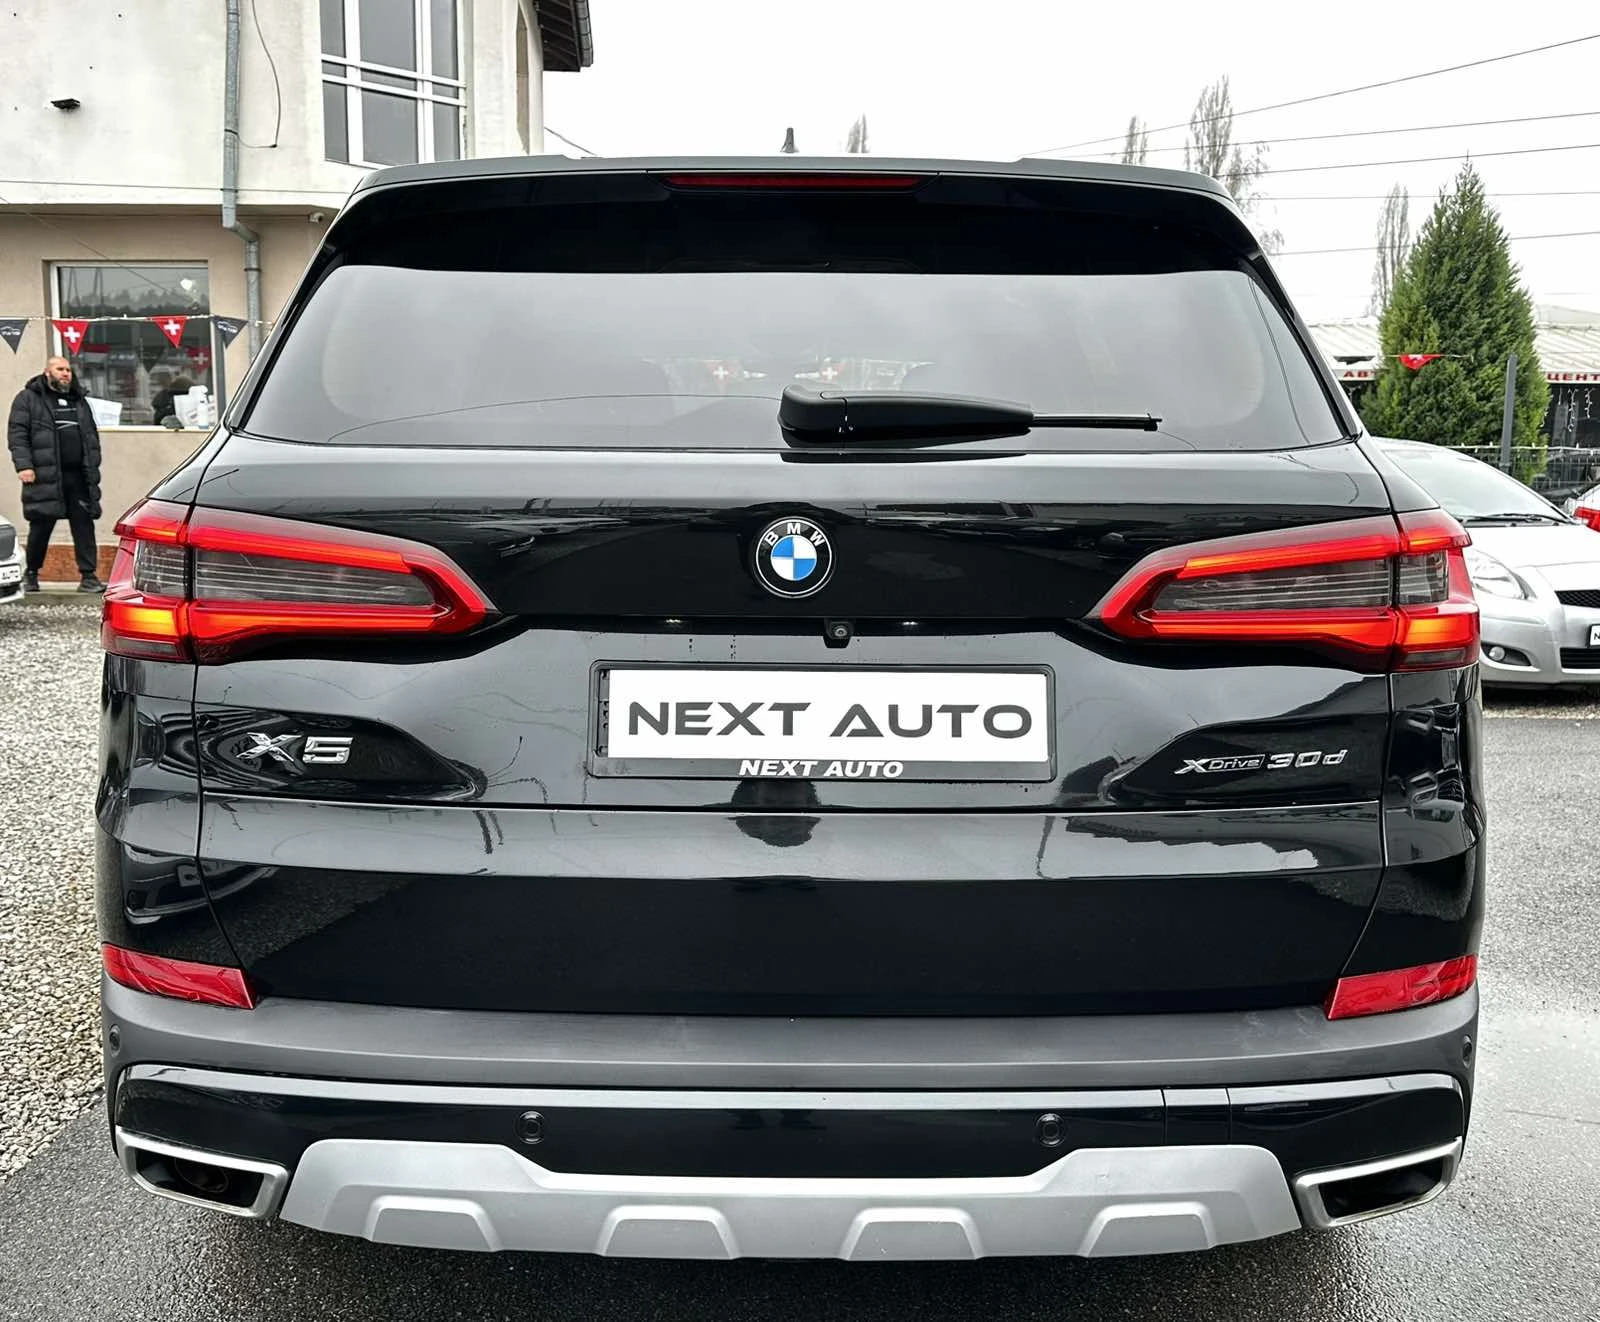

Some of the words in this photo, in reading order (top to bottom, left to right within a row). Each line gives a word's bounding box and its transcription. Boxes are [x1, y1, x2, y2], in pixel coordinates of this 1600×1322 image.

[764, 522, 825, 547] BMW
[628, 701, 812, 736] NEXT
[829, 703, 1032, 739] AUTO
[236, 732, 354, 764] X5
[1266, 749, 1348, 770] 30d
[738, 759, 818, 777] NEXT
[823, 761, 904, 778] AUTO
